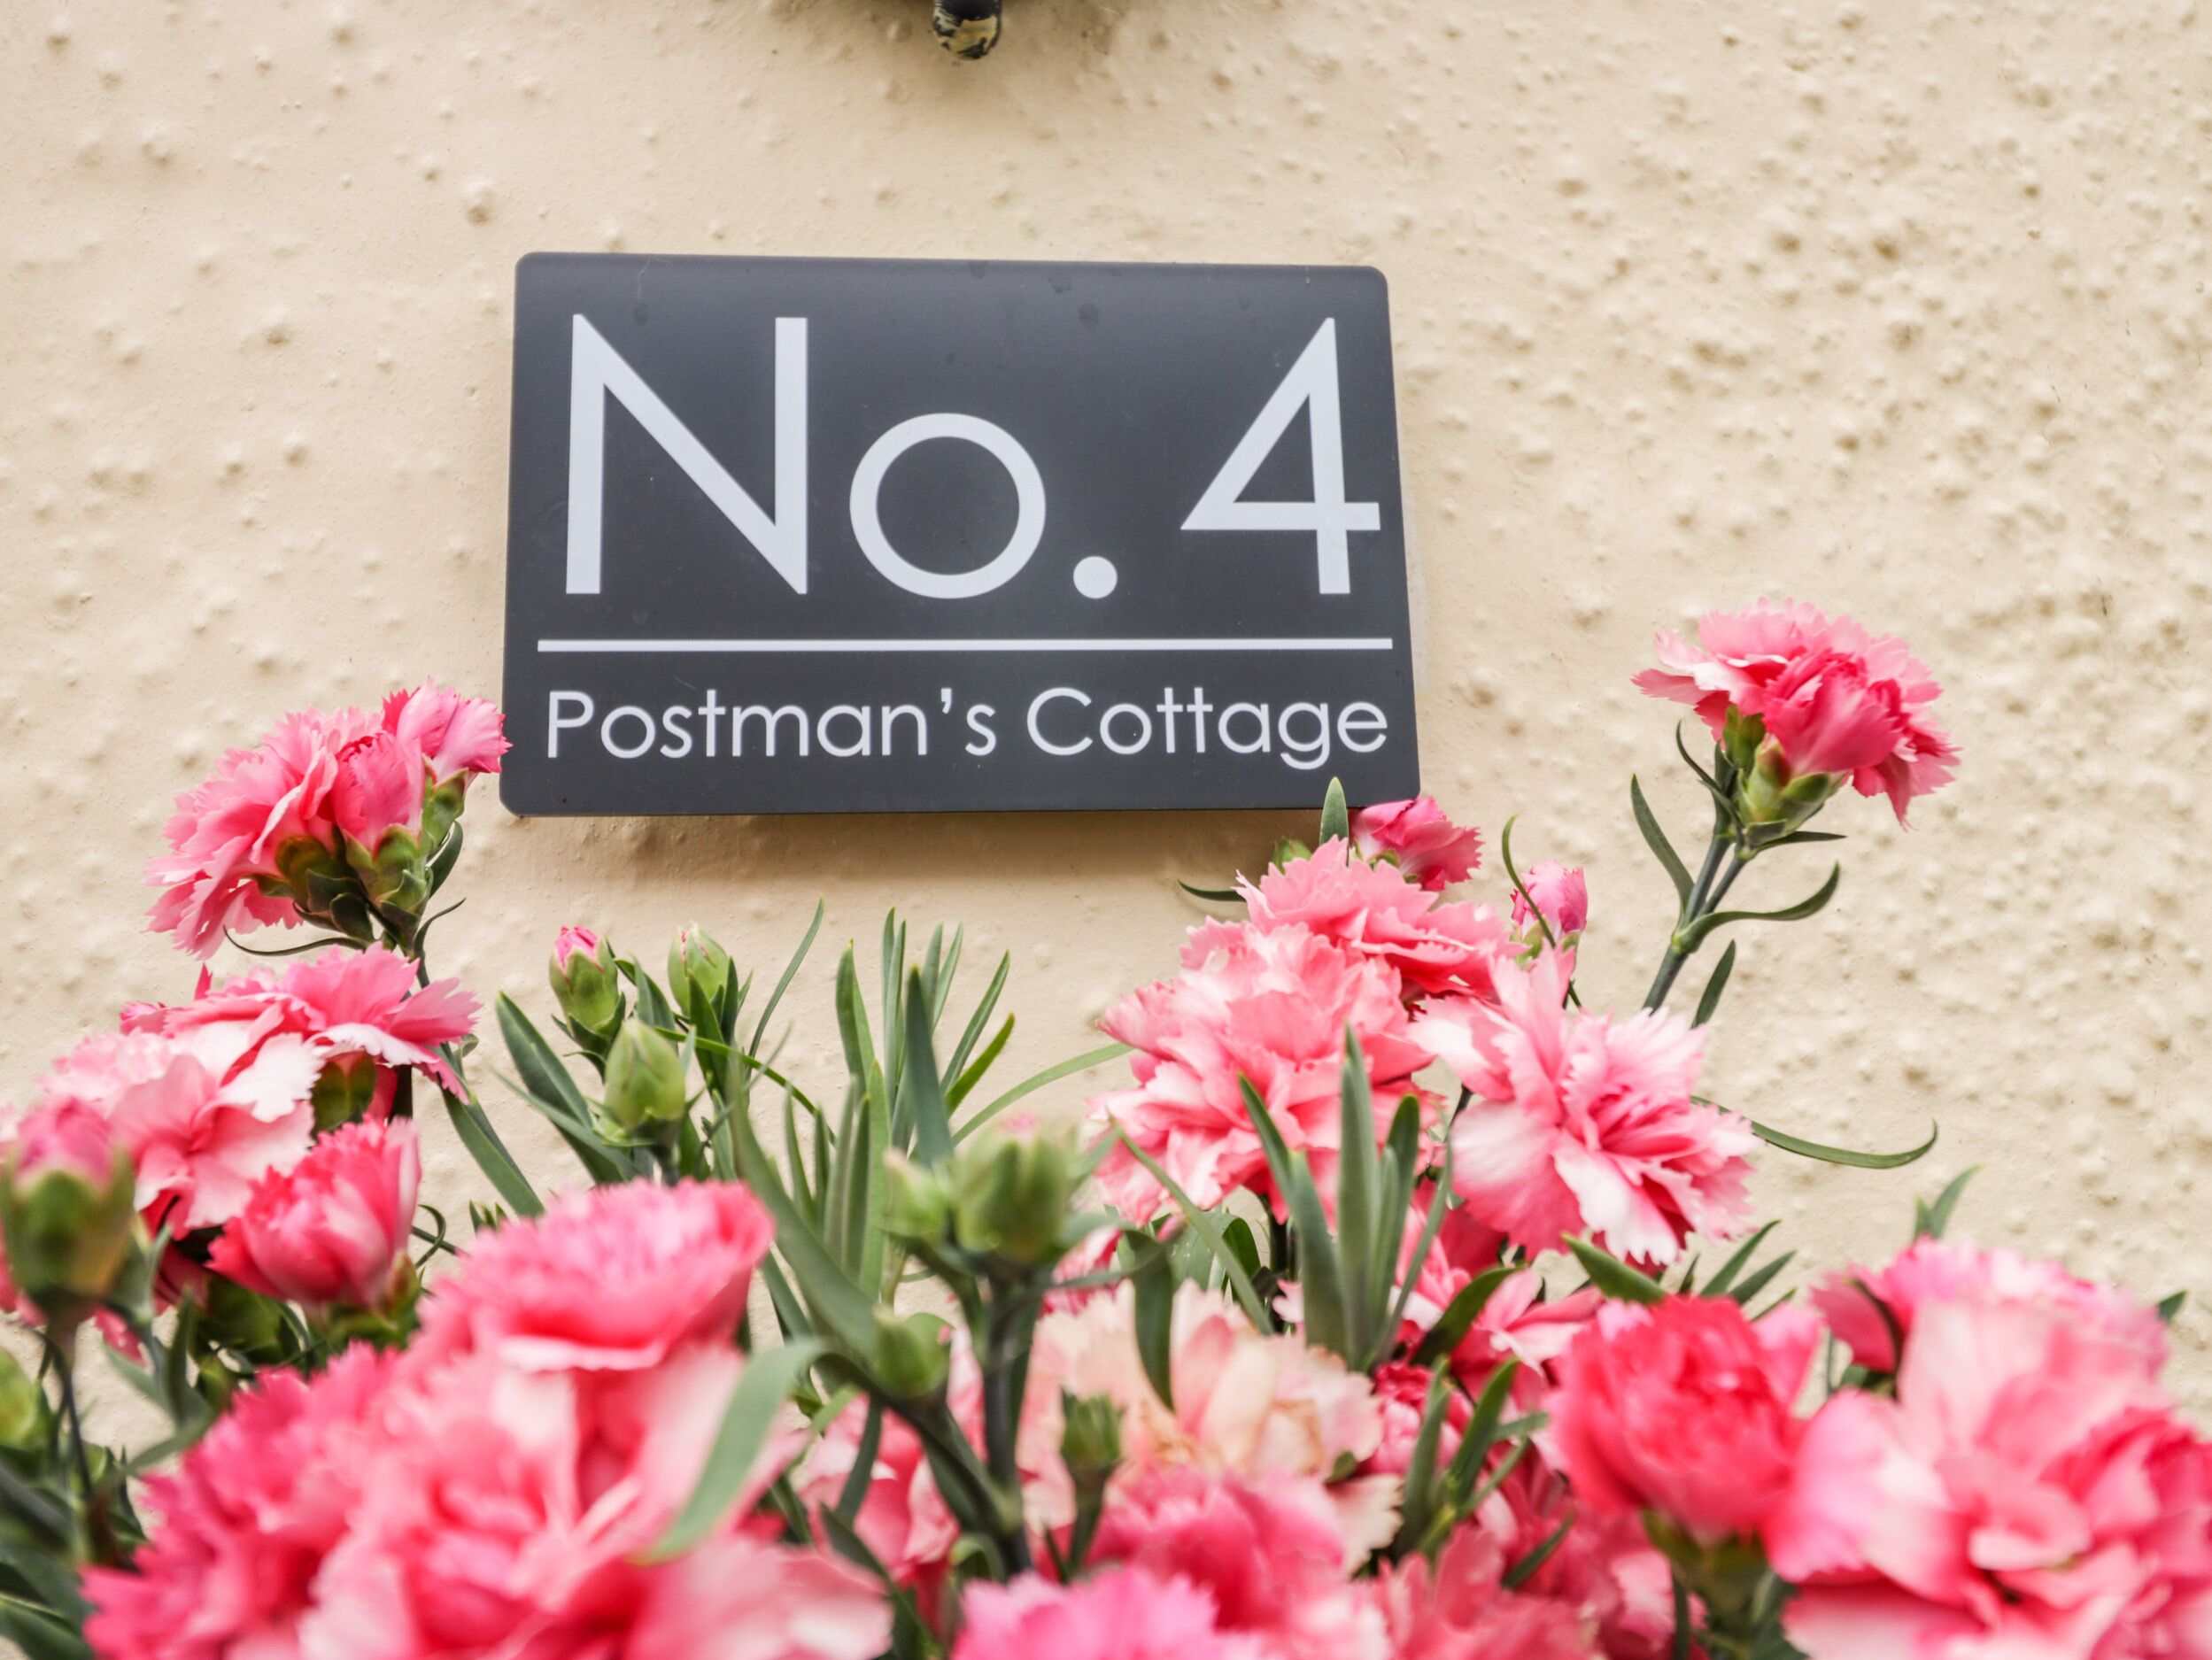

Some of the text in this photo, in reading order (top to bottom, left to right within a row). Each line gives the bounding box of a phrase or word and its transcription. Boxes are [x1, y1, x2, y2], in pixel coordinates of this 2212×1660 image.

[565, 313, 1381, 599] No. 4
[547, 686, 1388, 770] Postman's Cottage
